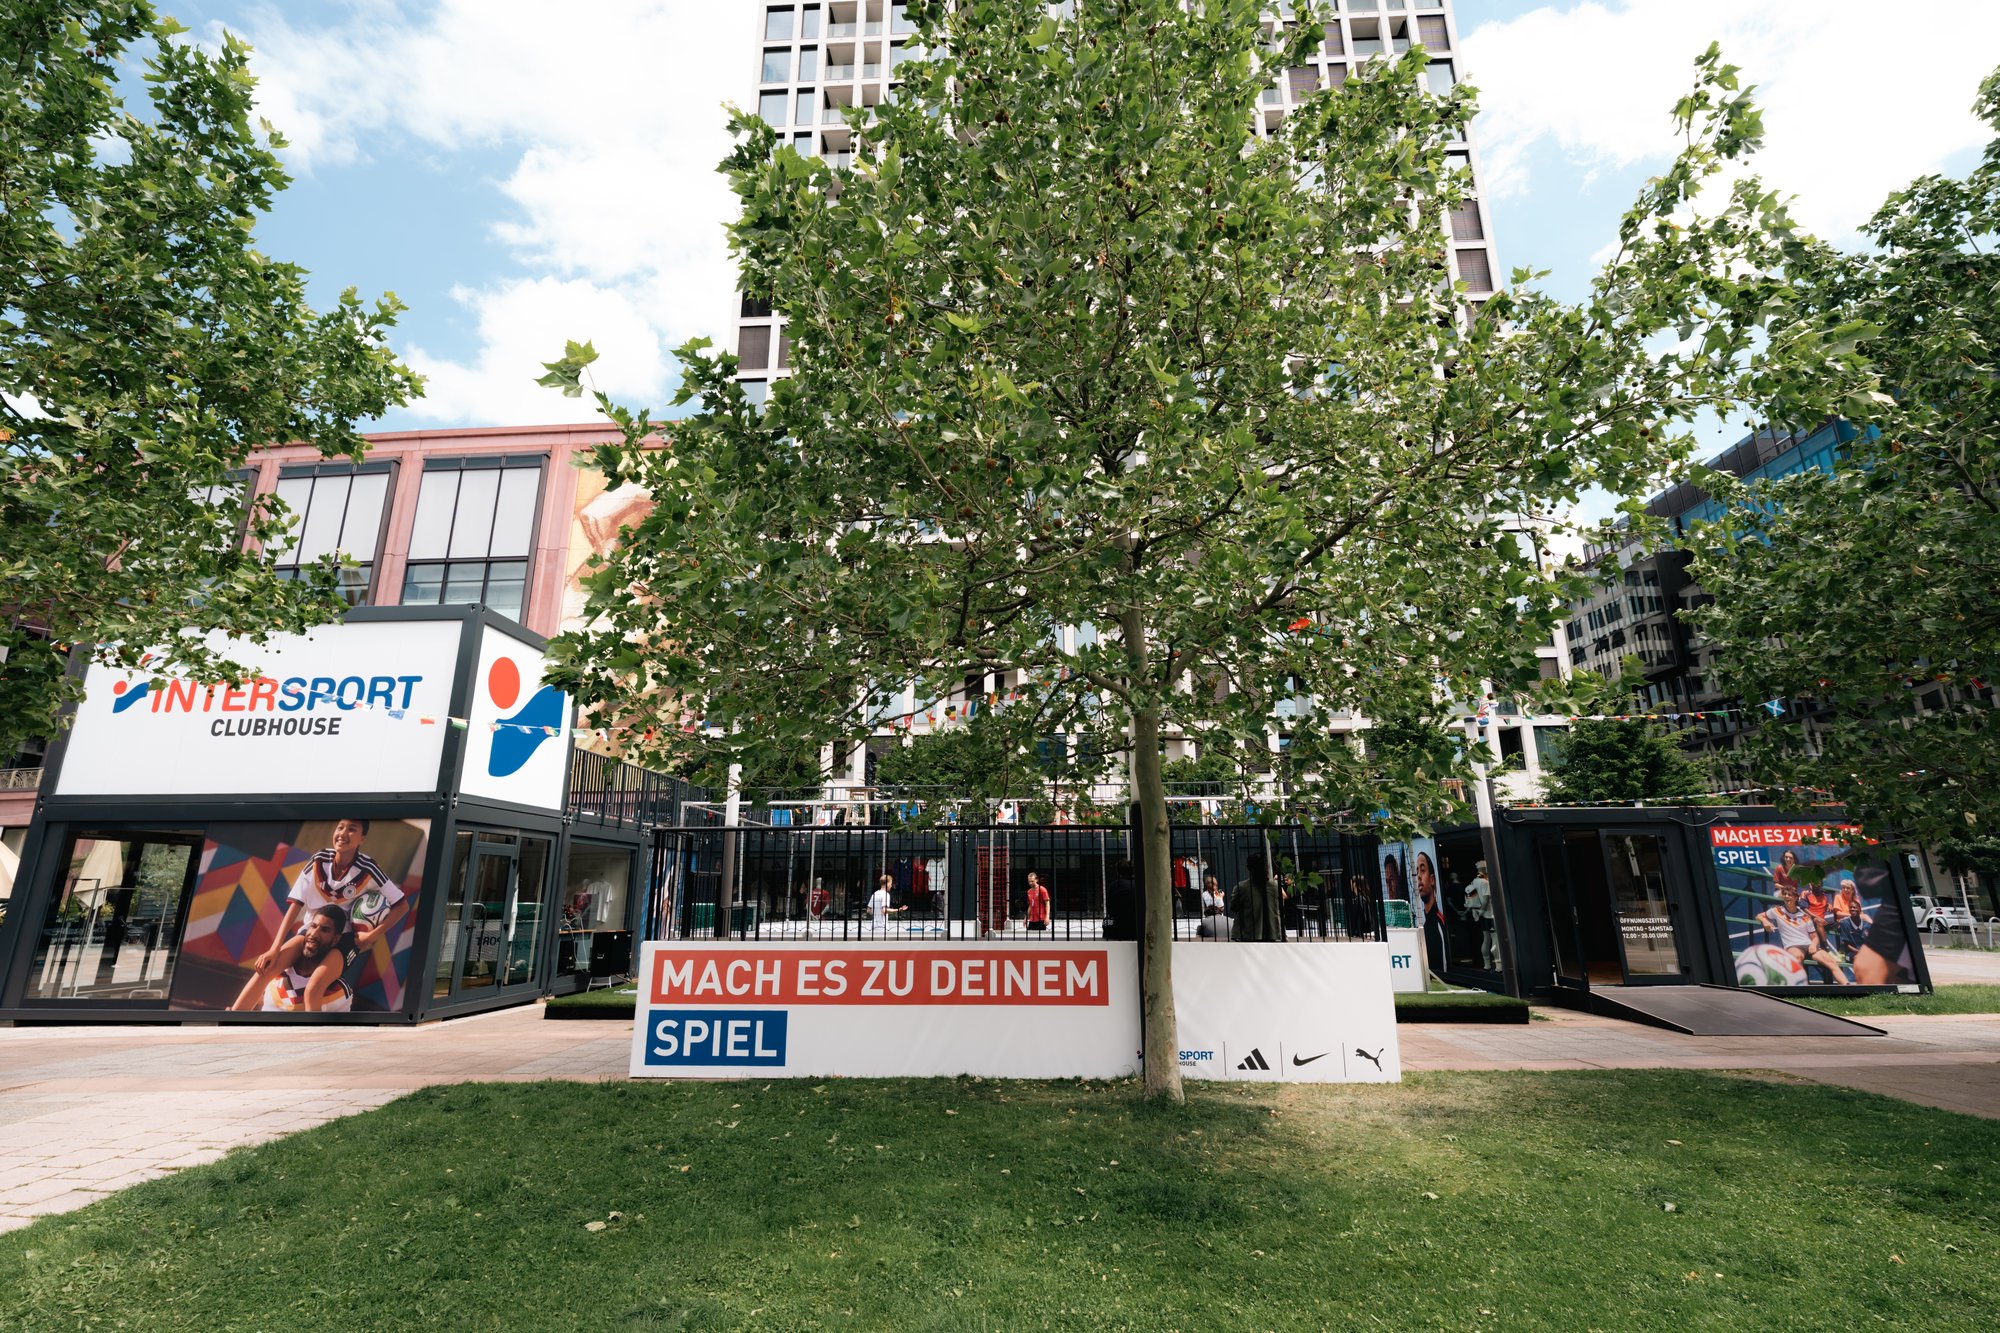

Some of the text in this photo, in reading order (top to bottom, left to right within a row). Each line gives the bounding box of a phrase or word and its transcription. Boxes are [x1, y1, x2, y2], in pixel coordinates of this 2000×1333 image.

[151, 676, 423, 713] INTERSPORT
[210, 717, 342, 737] CLUBHOUSE
[1713, 829, 1759, 844] MACH
[1765, 829, 1785, 843] ES
[1718, 850, 1767, 865] SPIEL
[660, 959, 1099, 997] MACH ES ZU DEINEM
[653, 1019, 778, 1057] SPIEL
